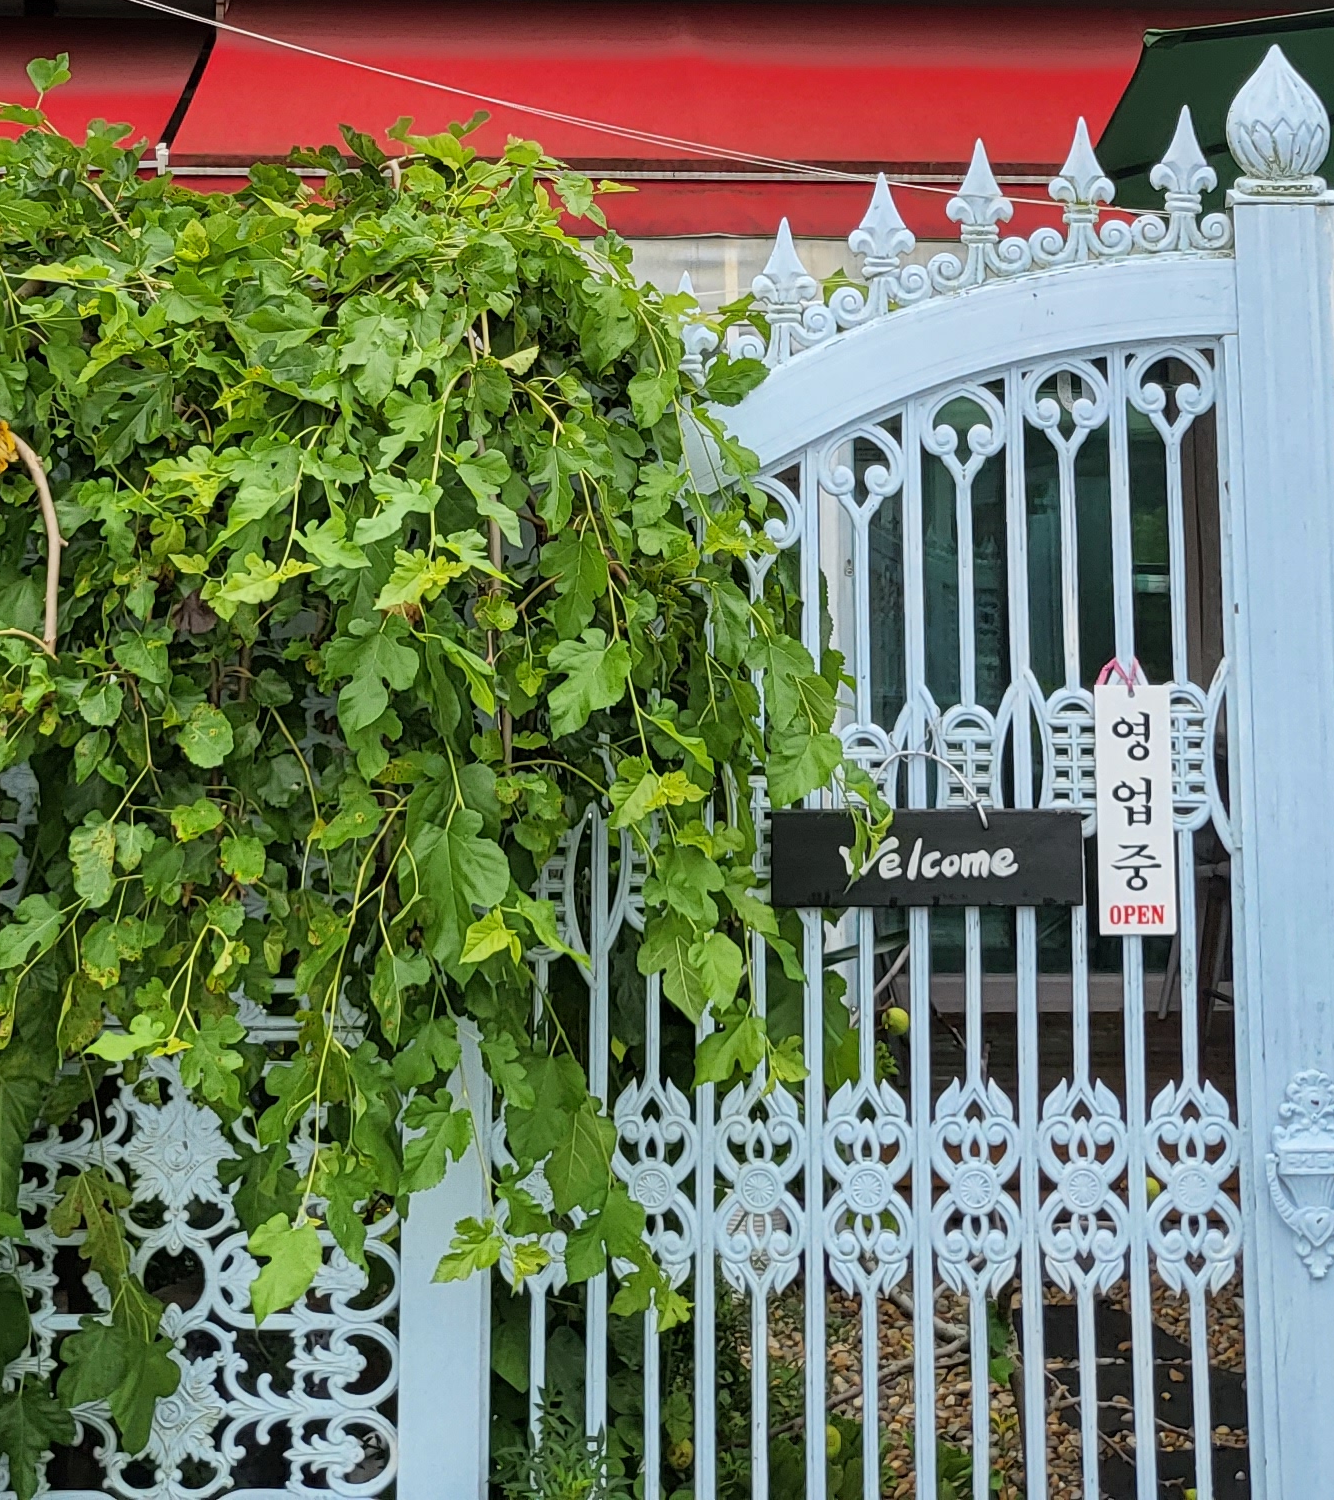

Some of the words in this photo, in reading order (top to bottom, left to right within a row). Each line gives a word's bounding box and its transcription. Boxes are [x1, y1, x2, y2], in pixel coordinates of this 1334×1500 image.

[1110, 711, 1163, 892] 영업중
[838, 835, 1020, 882] Welcome
[1108, 904, 1166, 926] OPEN
